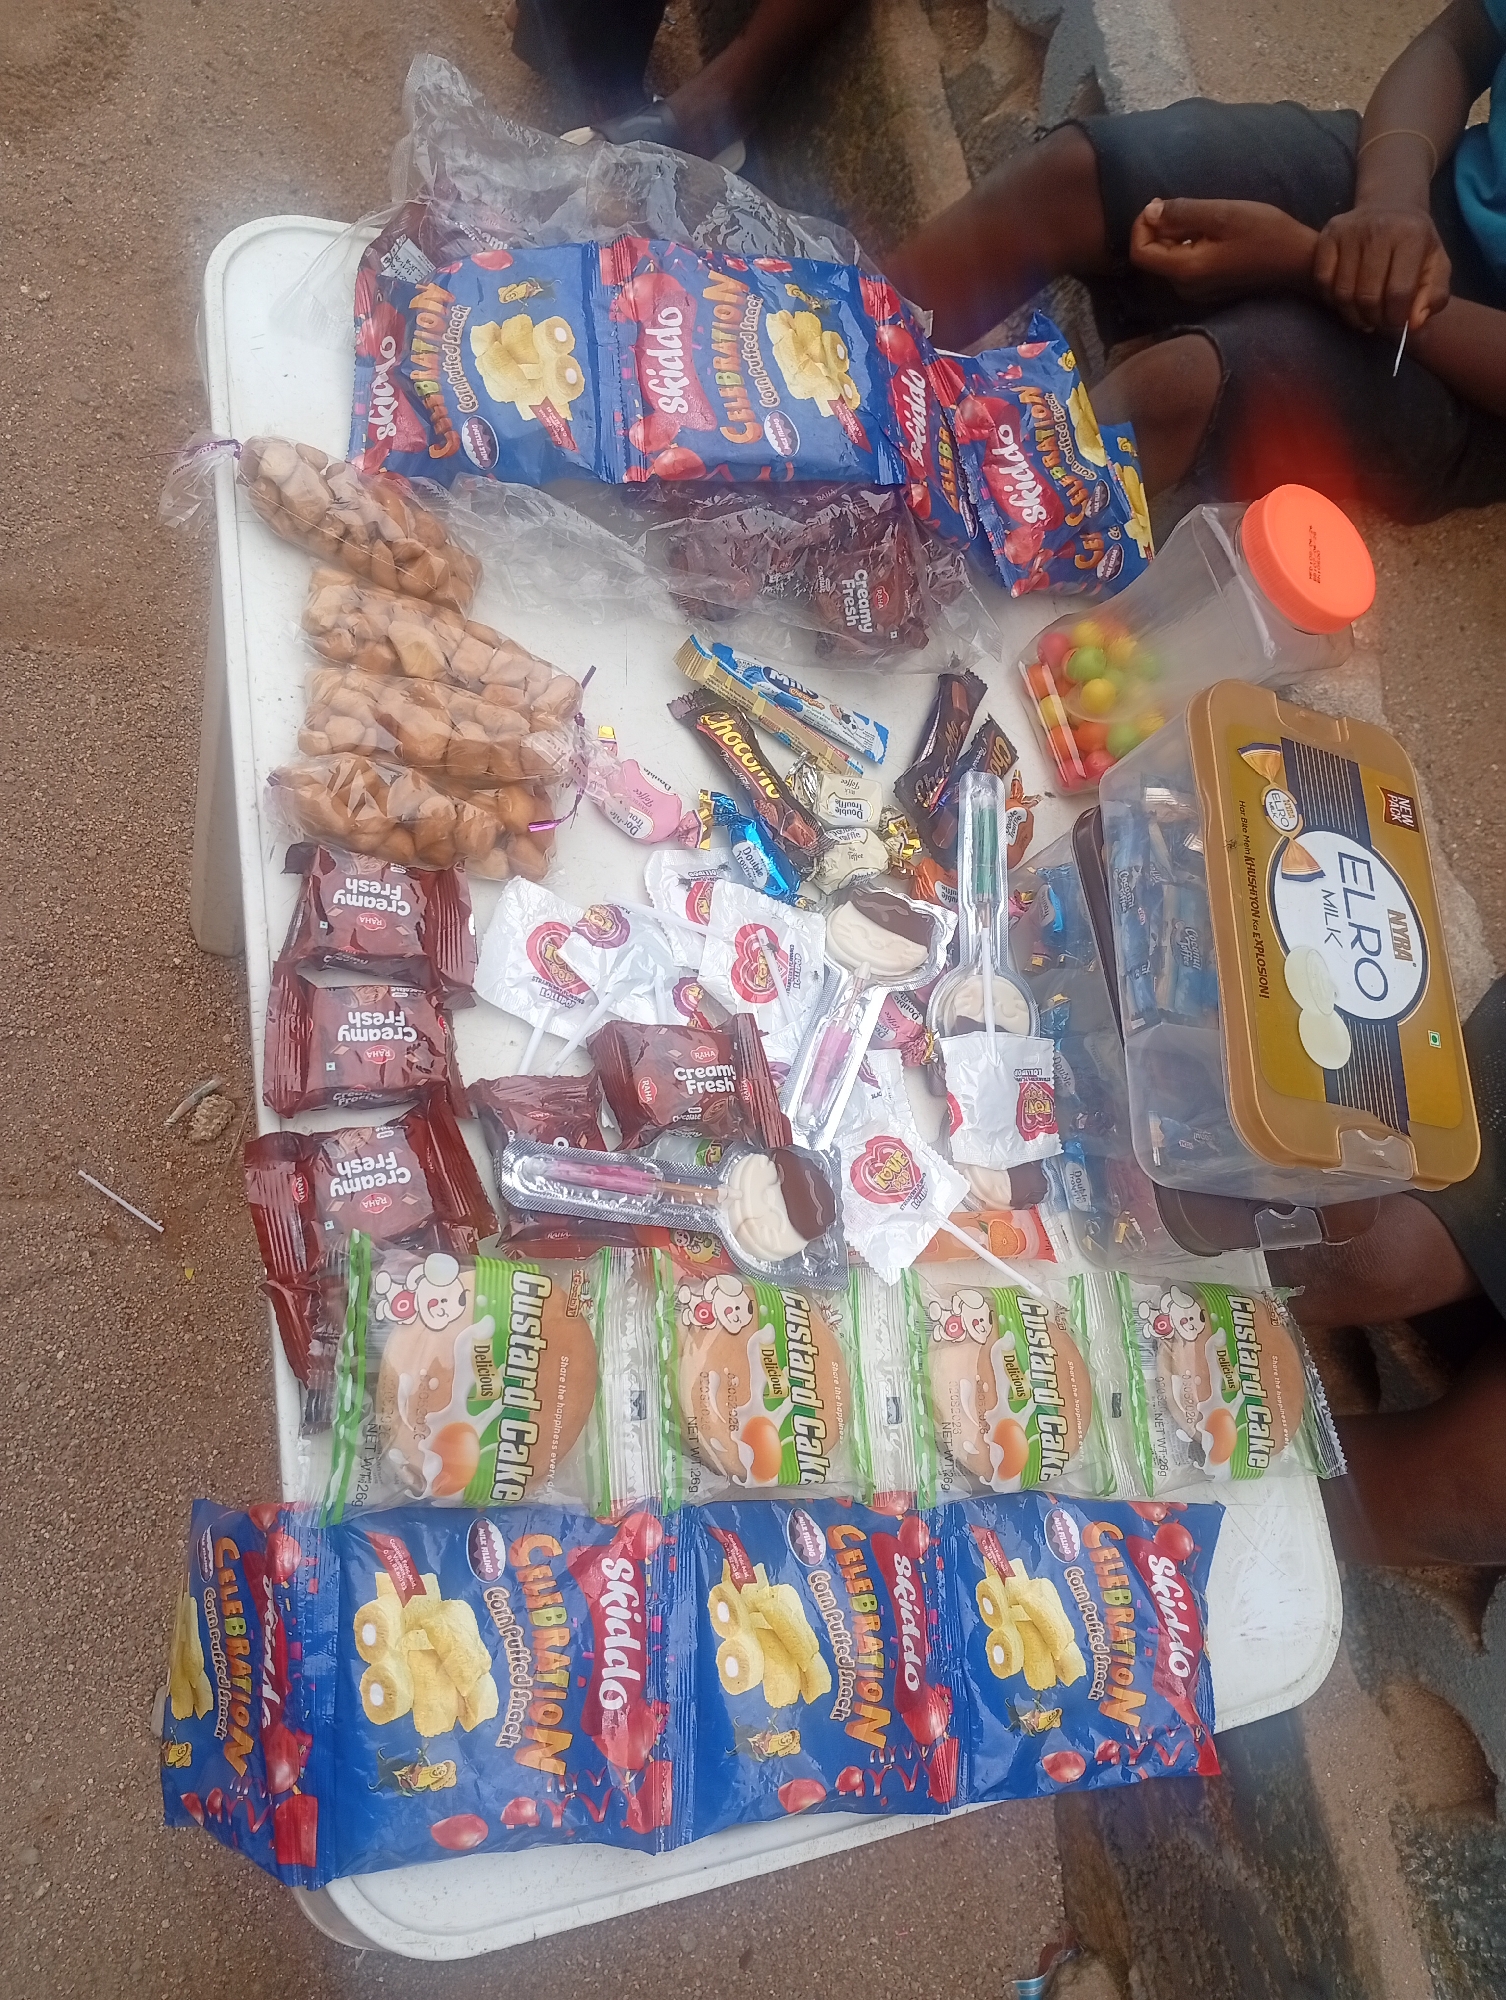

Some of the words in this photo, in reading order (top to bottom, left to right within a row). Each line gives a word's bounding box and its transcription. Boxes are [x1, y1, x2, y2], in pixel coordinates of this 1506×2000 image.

[740, 294, 763, 331] Snack
[409, 283, 460, 459] CELEBRATION
[706, 270, 763, 445] CELEBRATION
[456, 383, 480, 414] Corn
[759, 378, 780, 408] Corn
[1010, 386, 1089, 527] CELEBRATION
[840, 578, 857, 628] Fresh
[854, 569, 873, 633] Creamy
[875, 589, 885, 609] RAHA
[841, 779, 860, 790] Toffee
[835, 808, 863, 820] Double
[1268, 802, 1278, 819] MILK
[1271, 792, 1289, 828] ELRO
[1387, 794, 1401, 822] PACK
[1398, 797, 1415, 828] NEW
[743, 846, 764, 877] Double
[333, 889, 411, 916] Creamy
[345, 877, 403, 901] Fresh
[359, 917, 384, 926] RAHA
[1243, 834, 1251, 855] Mein
[1252, 932, 1270, 999] EXPLOSION!
[1321, 889, 1343, 949] MILK
[1338, 852, 1389, 1002] ELRO
[1184, 926, 1202, 970] Coconut
[1387, 909, 1413, 962] NYRA
[1179, 941, 1191, 968] Toffee
[348, 1010, 406, 1027] Fresh
[894, 995, 920, 1021] Double
[337, 1024, 418, 1043] Creamy
[366, 1050, 392, 1059] RAHA
[694, 1050, 717, 1060] RAHA
[673, 1064, 737, 1081] Creamy
[686, 1079, 735, 1095] Fresh
[642, 1080, 653, 1103] RAHA
[337, 1151, 398, 1176] Fresh
[295, 1176, 304, 1202] RAHA
[330, 1166, 411, 1198] Creamy
[362, 1198, 388, 1209] RAHA
[502, 1271, 553, 1411] Custard
[779, 1287, 826, 1409] Custard
[1016, 1295, 1065, 1407] Custard
[1227, 1295, 1268, 1398] Custard
[474, 1344, 495, 1398] Delicious
[560, 1355, 569, 1383] Share
[761, 1348, 783, 1395] Delicious
[831, 1361, 839, 1385] Share
[1003, 1354, 1026, 1397] Delicious
[1216, 1350, 1236, 1389] Delicious
[560, 1384, 568, 1396] the
[834, 1386, 842, 1397] the
[1067, 1361, 1076, 1383] Share
[1074, 1395, 1085, 1433] happiness
[1271, 1355, 1279, 1376] Share
[1276, 1388, 1288, 1422] happiness
[552, 1396, 565, 1443] happiness
[687, 1416, 698, 1443] NET
[941, 1421, 953, 1444] NET
[1152, 1413, 1166, 1434] NET
[1246, 1404, 1275, 1469] Cake
[364, 1423, 378, 1452] NET
[1036, 1414, 1069, 1482] Cake
[490, 1418, 540, 1502] Cake
[549, 1445, 558, 1480] every
[687, 1447, 702, 1493] WT:26g
[1155, 1437, 1171, 1477] WT:26g
[478, 1526, 488, 1549] MILK
[797, 1515, 808, 1534] MILK
[1054, 1516, 1064, 1534] MILK
[1059, 1533, 1072, 1556] FILLING
[481, 1549, 494, 1575] FILLING
[802, 1533, 815, 1558] FILLING
[483, 1587, 516, 1633] Corn
[1082, 1521, 1147, 1727] CELEBRATION
[808, 1569, 837, 1612] Corn
[830, 1665, 857, 1722] Snack
[827, 1524, 892, 1749] CELEBRATION
[1064, 1566, 1090, 1605] Corn
[1088, 1653, 1111, 1700] Snack
[202, 1586, 217, 1630] Corn
[213, 1688, 232, 1740] Snack
[214, 1536, 255, 1777] CELEBRATION
[508, 1533, 574, 1776] CELEBRATION
[494, 1689, 532, 1750] Snack
